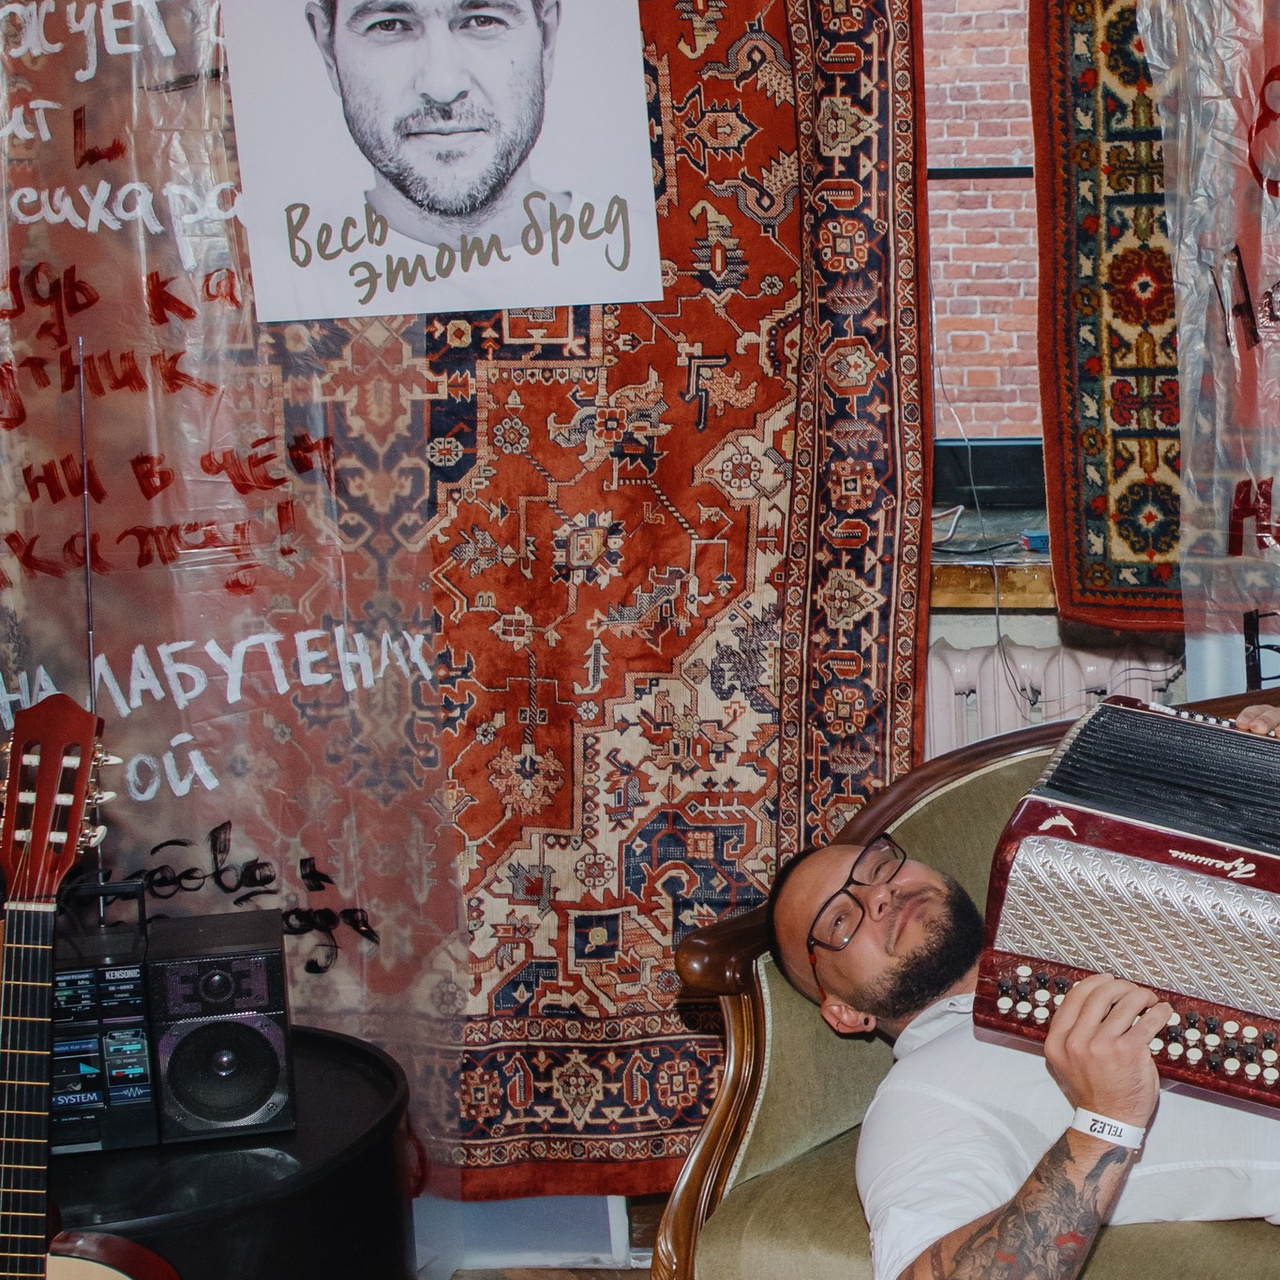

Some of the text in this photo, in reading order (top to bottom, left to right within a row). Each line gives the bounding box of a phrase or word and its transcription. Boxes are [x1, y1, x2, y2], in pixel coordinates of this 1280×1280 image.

[284, 202, 389, 268] Весь
[348, 190, 631, 305] этот бред
[105, 969, 140, 980] KENSONIC
[57, 1092, 98, 1105] SYSTEM
[1089, 1118, 1124, 1138] TELE2
